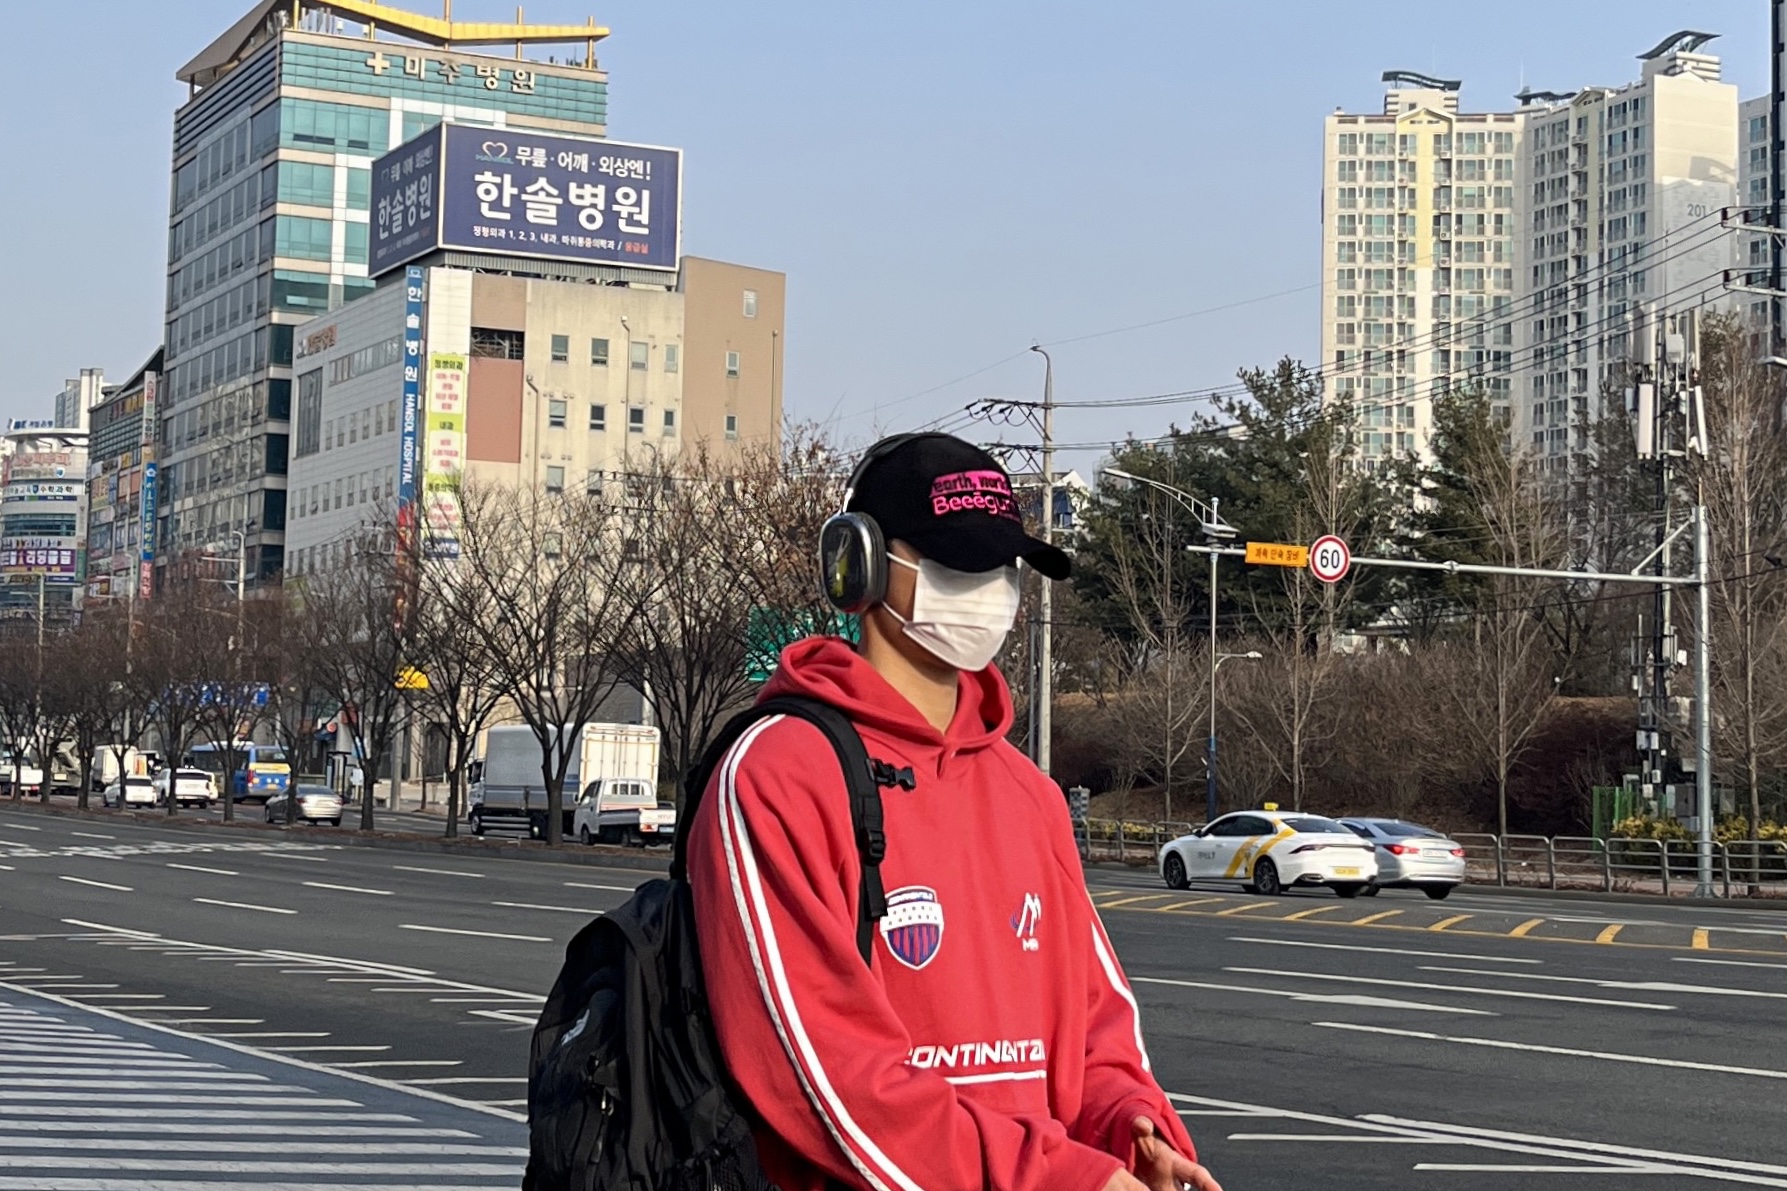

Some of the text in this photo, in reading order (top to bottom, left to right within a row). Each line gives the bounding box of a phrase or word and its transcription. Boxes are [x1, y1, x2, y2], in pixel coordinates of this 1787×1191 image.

[404, 56, 535, 95] 미주병원
[515, 146, 651, 181] 무릎 어깨 외상엔!
[378, 172, 432, 240] 한솔병원
[474, 170, 650, 235] 한솔병원
[473, 225, 506, 239] 정형외과
[405, 286, 422, 382] 한솔병원
[402, 393, 415, 484] HANSOL HOSPITAL
[1320, 549, 1340, 569] 60
